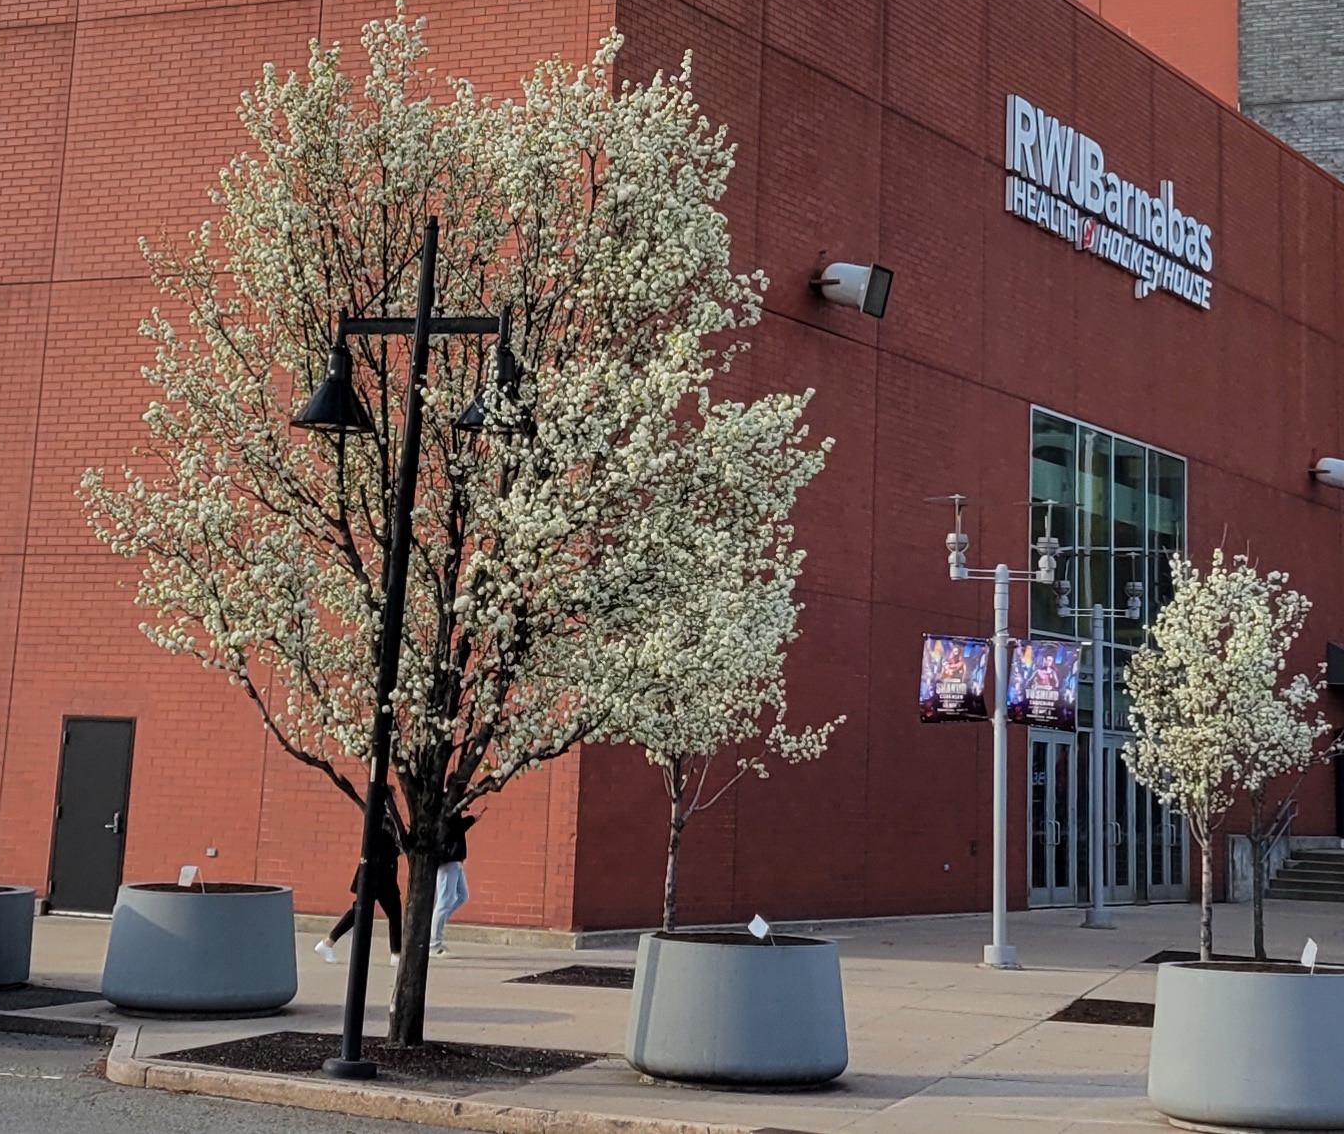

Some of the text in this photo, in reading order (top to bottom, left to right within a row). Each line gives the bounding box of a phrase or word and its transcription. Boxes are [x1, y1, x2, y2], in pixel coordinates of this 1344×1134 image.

[1006, 94, 1212, 272] RWJBarnabas
[1006, 176, 1079, 244] HEALTH
[1094, 224, 1161, 298] HOCKEY
[1163, 258, 1212, 309] HOUSE
